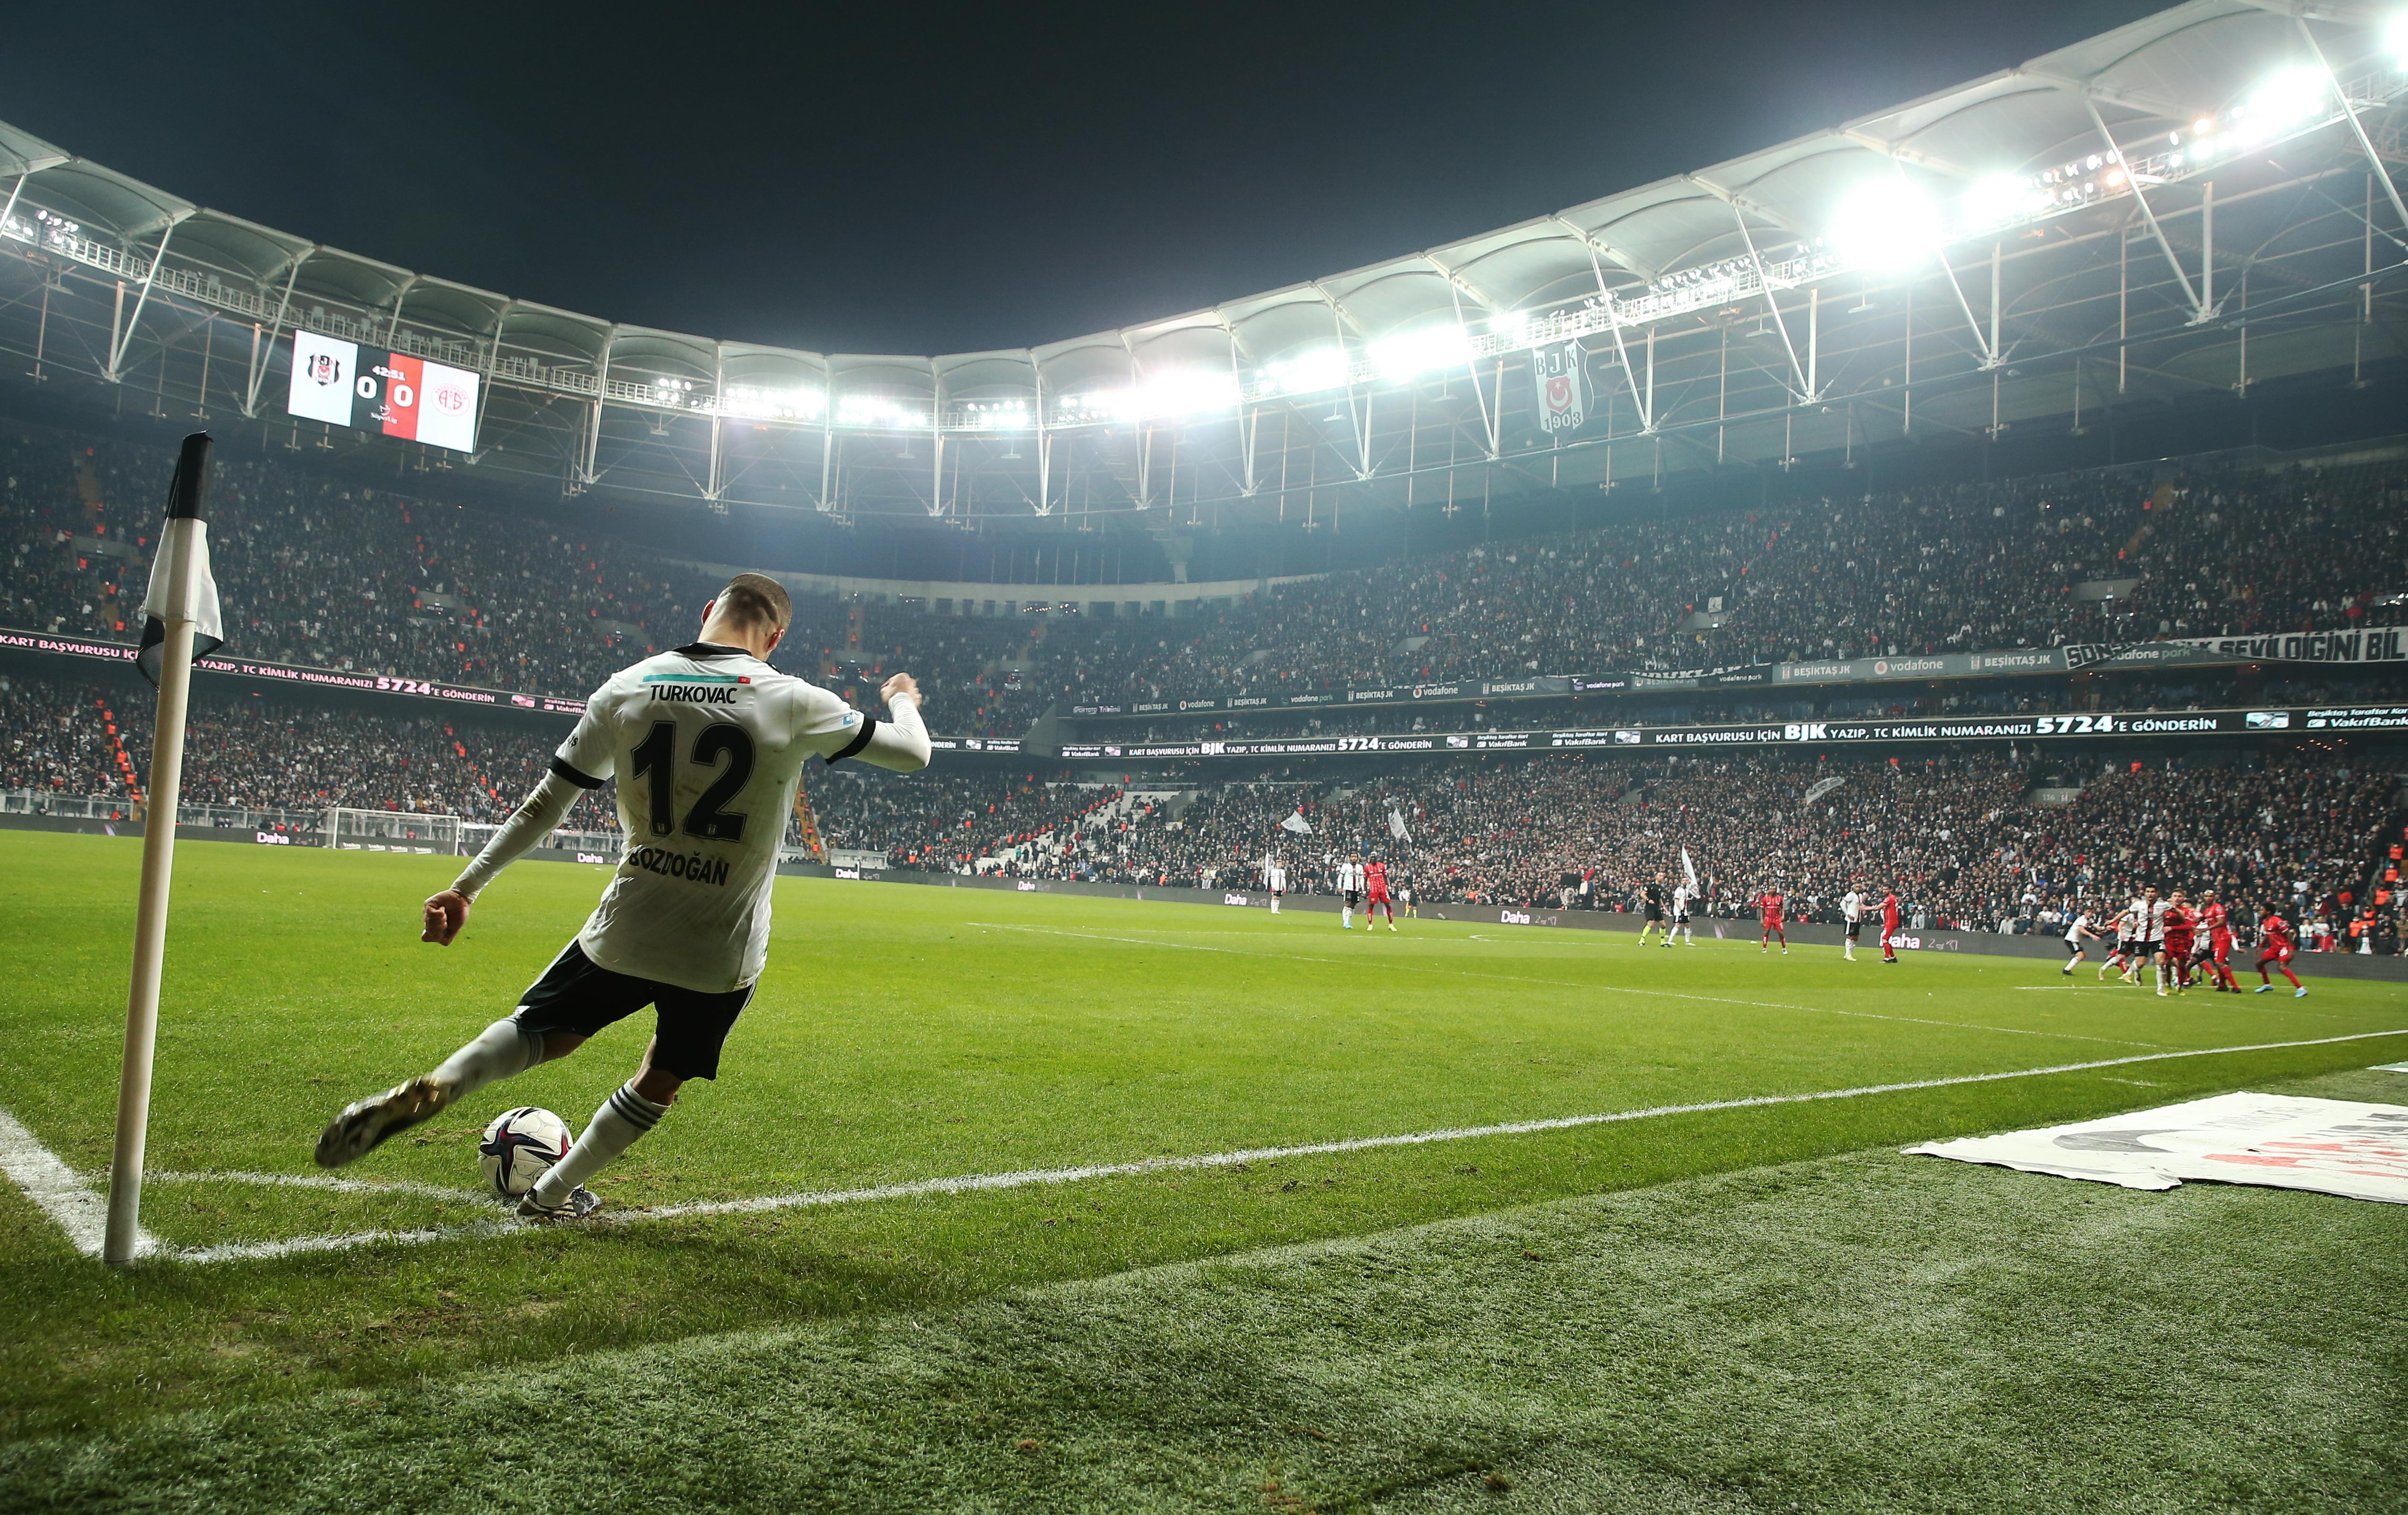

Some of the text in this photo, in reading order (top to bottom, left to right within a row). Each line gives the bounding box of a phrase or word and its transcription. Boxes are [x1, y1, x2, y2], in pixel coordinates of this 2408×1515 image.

[1535, 349, 1577, 375] BJK
[372, 365, 406, 382] 42:51
[356, 376, 378, 399] 0
[393, 384, 414, 407] 0
[1544, 411, 1582, 430] 1903
[1984, 654, 2051, 668] BEŞİKTAŞ JK
[2111, 649, 2159, 661] odafone
[0, 635, 35, 647] KART
[38, 639, 121, 657] BAŞVURUSU
[122, 648, 139, 661] İÇİ
[200, 660, 238, 673] YAZIP,
[242, 665, 256, 674] TC
[259, 665, 299, 679] KİMLİK
[301, 670, 374, 688] NUMARANIZI
[442, 688, 496, 703] GÖNDERİN
[1890, 659, 1943, 671] vodafone
[1748, 673, 1762, 682] park
[1794, 665, 1850, 678] BEŞİKTAŞ JK
[1422, 685, 1458, 696] vodafone
[1492, 682, 1535, 693] BEŞİKTAŞ JK
[650, 684, 738, 704] TURKOVAC
[1290, 694, 1333, 703] vodafone park
[1356, 690, 1385, 700] BEŞİKTAŞ
[1187, 699, 1215, 708] vodafone
[1234, 698, 1260, 706] BEŞİKTAŞ
[556, 704, 586, 714] VakıfBa
[2330, 715, 2408, 727] VakıfBank
[1656, 733, 1684, 743] KART
[1686, 731, 1755, 744] BAŞVURUSU
[1757, 729, 1782, 743] İÇİN
[1784, 723, 1827, 742] BJK
[1830, 728, 1869, 740] YAZIP,
[1873, 728, 1888, 738] TC
[1892, 725, 1937, 737] KİMLİK
[1941, 724, 2031, 736] NUMARANIZI
[2132, 717, 2217, 731] GÖNDERİN
[930, 740, 956, 750] NDERİN
[1146, 748, 1185, 757] BAŞVURUSU
[1186, 746, 1200, 756] İÇİN
[1201, 742, 1225, 755] BJK
[1226, 746, 1249, 754] YAZIP,
[1250, 745, 1259, 753] TC
[1259, 744, 1286, 753] KİMLİK
[1287, 743, 1336, 752] NUMARANIZI
[1388, 739, 1432, 749] GÖNDERİN
[1565, 738, 1608, 747] VakıfBank
[630, 720, 756, 844] 12
[256, 831, 289, 845] Daha
[577, 852, 604, 864] Daha
[629, 850, 730, 887] BOZDOĞAN
[835, 868, 859, 879] Daha
[1017, 880, 1035, 891] Daha
[1224, 893, 1247, 906] Daha
[1501, 910, 1530, 924] Daha
